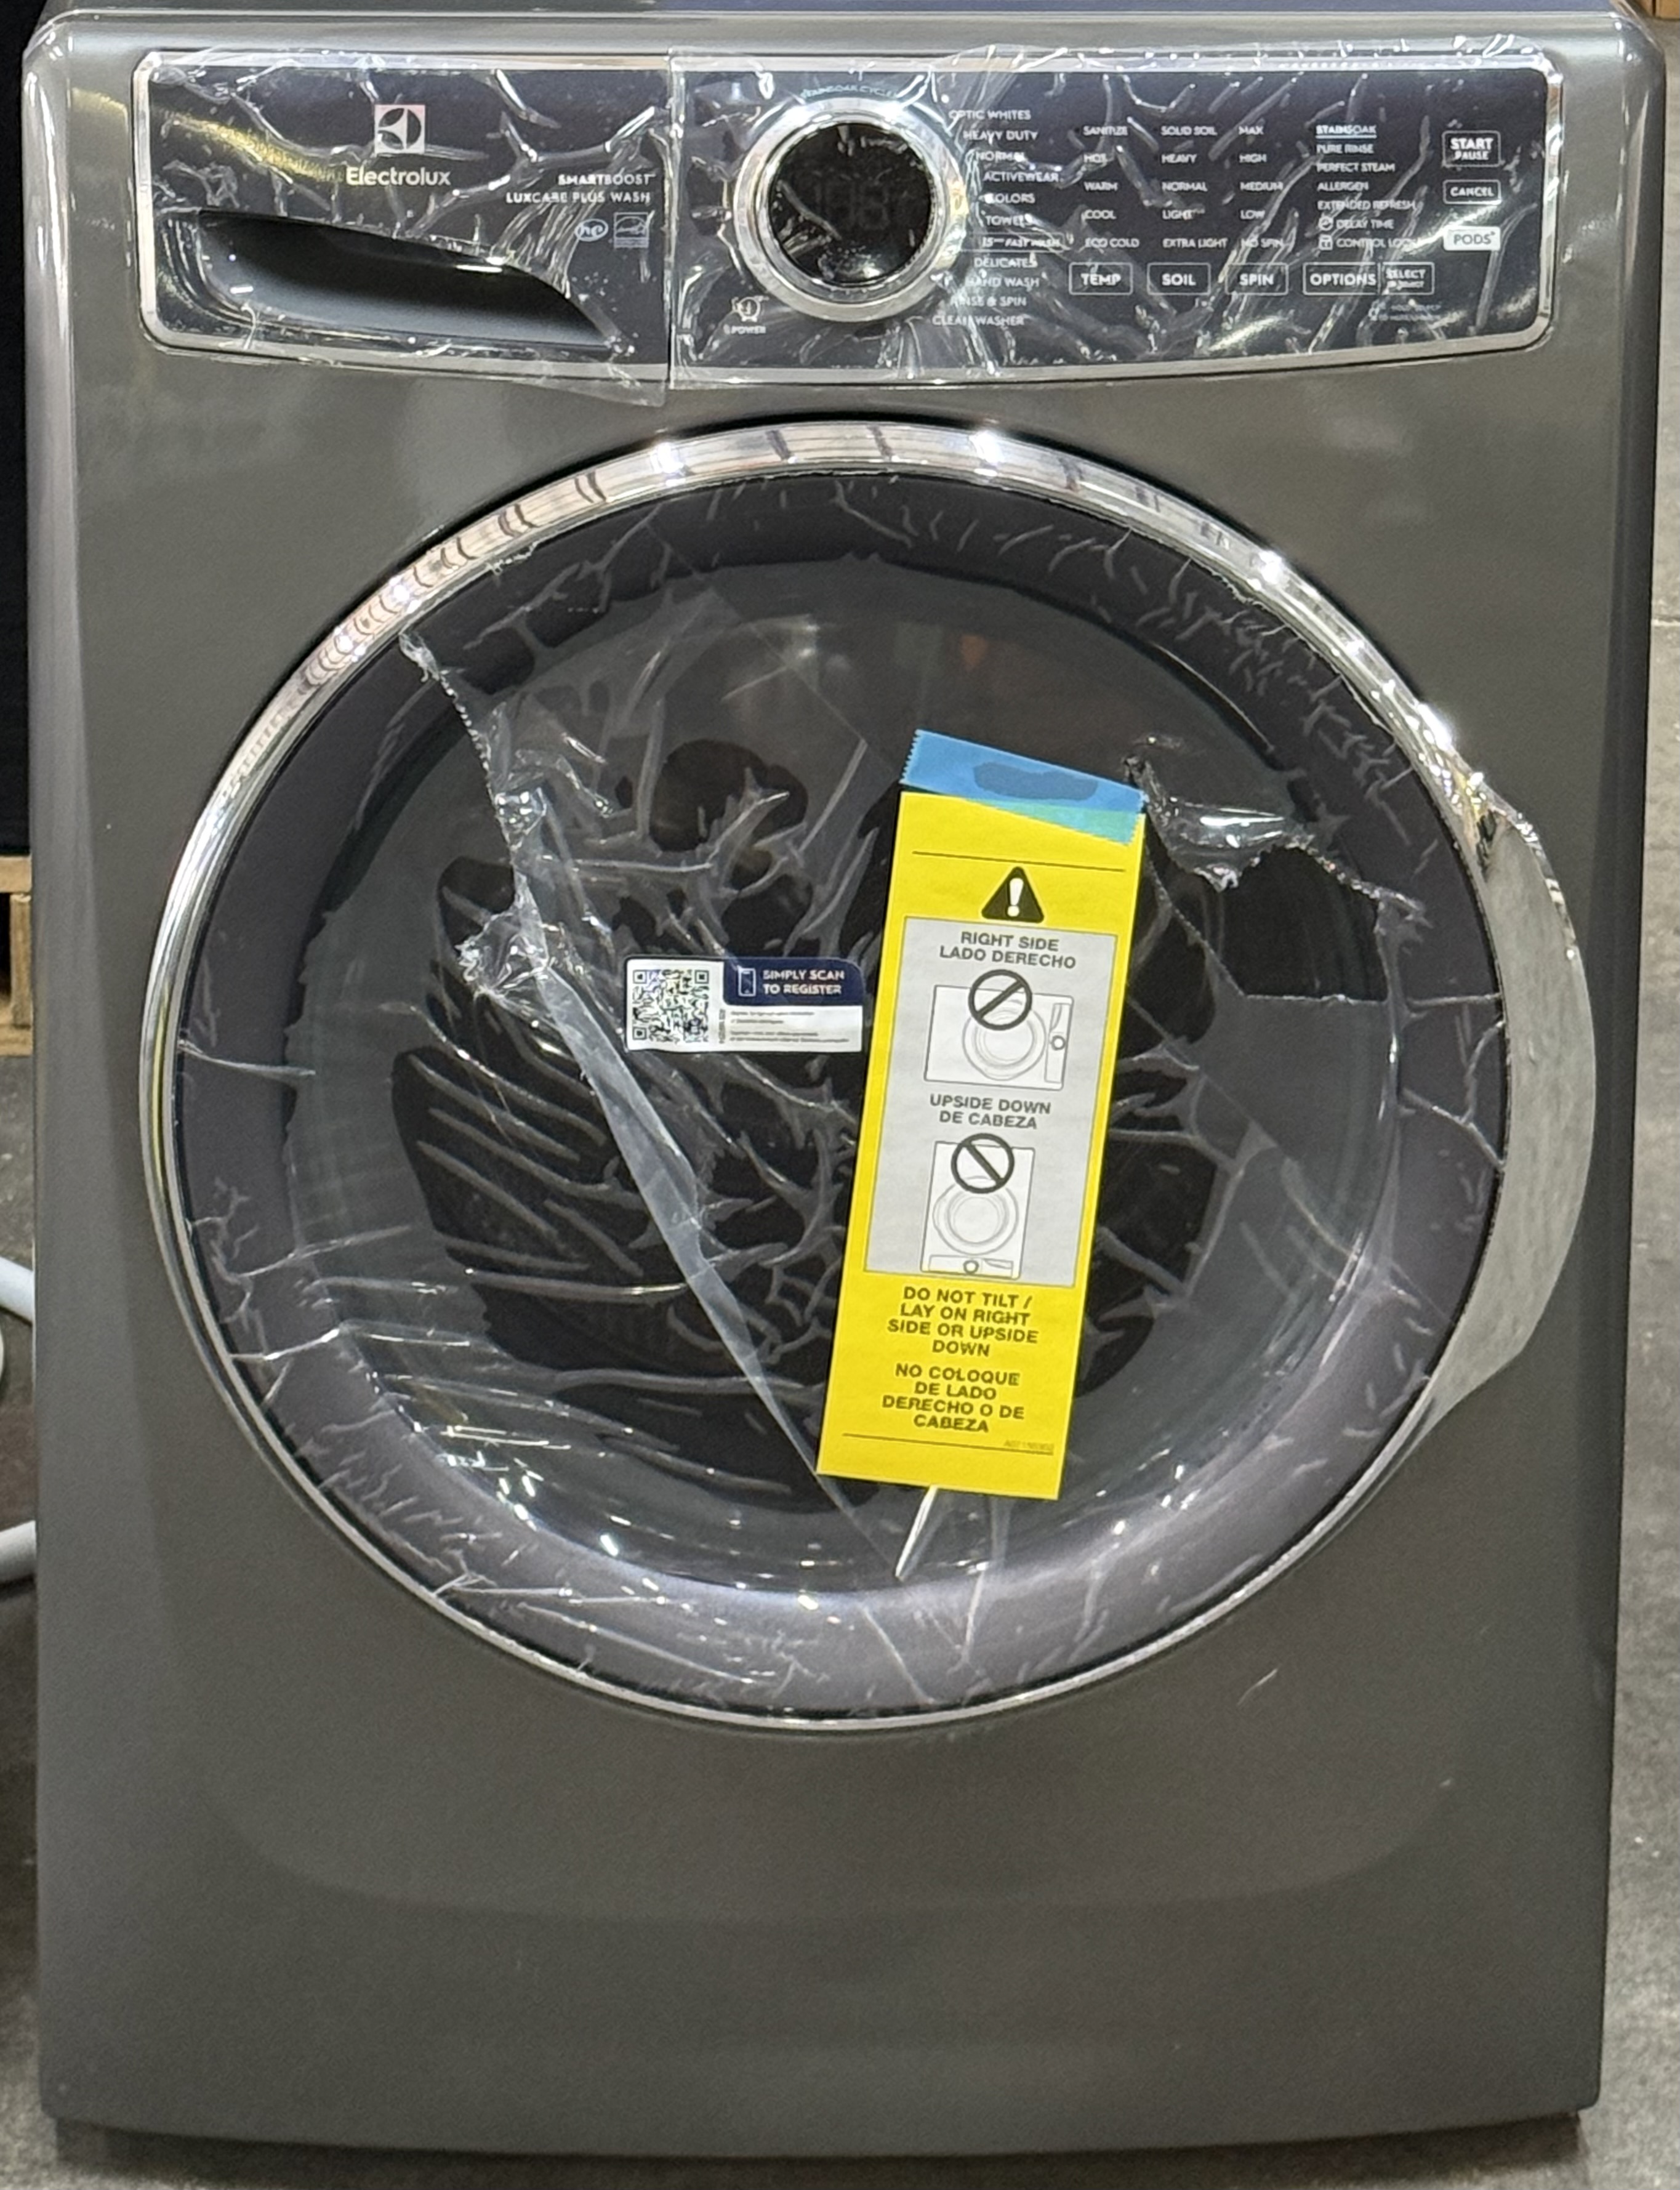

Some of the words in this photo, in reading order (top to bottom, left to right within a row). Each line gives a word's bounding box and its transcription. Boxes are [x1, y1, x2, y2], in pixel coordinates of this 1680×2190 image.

[948, 110, 985, 120] OPTIC
[987, 110, 1032, 121] WHITES
[1083, 126, 1128, 136] SANITIZE
[1161, 126, 1192, 136] SOLID
[1193, 126, 1218, 136] SOIL
[1238, 126, 1264, 135] MAX
[1316, 125, 1377, 135] STAINSOAK
[963, 131, 1003, 141] HEAVY
[1006, 131, 1039, 140] DUTY
[1316, 144, 1343, 154] PURE
[1344, 144, 1374, 154] RINSE
[1450, 137, 1494, 150] START
[1083, 154, 1109, 164] HOT
[1161, 154, 1198, 164] HEAVY
[1239, 154, 1267, 164] HIGH
[1454, 150, 1490, 161] PAUSE
[1317, 163, 1359, 172] PERFECT
[1361, 163, 1396, 172] STEAM
[345, 166, 451, 186] Electrolux
[558, 173, 650, 185] SMARTBOOST
[983, 171, 1059, 182] ACTIVEWEAR
[1083, 182, 1118, 191] WARM
[1162, 182, 1208, 192] NORMAL
[1240, 182, 1284, 191] MEDIUM
[1317, 182, 1369, 191] ALLERGEN
[1450, 186, 1495, 197] CANCEL
[505, 191, 568, 204] LUXCARE
[571, 191, 606, 204] PLUS
[609, 191, 651, 204] WASH
[985, 193, 1035, 204] OLORS
[1317, 200, 1371, 211] EXTENDED
[1372, 200, 1415, 211] REFRESH
[1084, 210, 1117, 220] COOL
[1162, 210, 1193, 220] LIGHT
[1240, 210, 1266, 220] LOW
[1336, 219, 1368, 230] DELAY
[1370, 219, 1394, 230] TIME
[1084, 238, 1108, 248] ECO
[1109, 238, 1140, 248] COLD
[1162, 238, 1196, 248] EXTRA
[1197, 238, 1229, 248] LIGHT
[1336, 238, 1386, 248] CONTROL
[1388, 238, 1418, 248] LOC
[974, 257, 1039, 268] DELICATES
[1386, 268, 1426, 279] SELECT
[1004, 277, 1040, 287] WASH
[1080, 273, 1122, 286] TEMP
[1161, 273, 1196, 286] SOIL
[1239, 274, 1274, 286] SPIN
[1309, 273, 1377, 286] OPTIONS
[999, 296, 1027, 306] SPIN
[975, 315, 1026, 326] WASHER
[960, 931, 1014, 949] RIGHT
[1018, 935, 1059, 952] SIDE
[939, 945, 986, 962] LADO
[991, 949, 1077, 970] DERECHO
[762, 969, 806, 981] SIMPLY
[809, 970, 845, 981] SCAN
[763, 983, 781, 995] TO
[782, 984, 842, 996] REGISTER
[930, 1093, 993, 1111] UPSIDE
[998, 1098, 1051, 1115] DOWN
[939, 1110, 963, 1125] DE
[968, 1113, 1037, 1130] CABEZA
[903, 1286, 930, 1301] DO
[936, 1288, 977, 1304] NOT
[981, 1292, 1019, 1309] TILT
[899, 1302, 934, 1318] LAY
[939, 1305, 967, 1322] ON
[973, 1308, 1031, 1327] RIGHT
[886, 1318, 931, 1335] SIDE
[937, 1322, 964, 1338] OR
[969, 1326, 1040, 1344] UPSIDE
[931, 1339, 991, 1357] DOWN
[894, 1362, 923, 1378] NO
[928, 1365, 1021, 1387] COLOQUE
[914, 1380, 941, 1396] DE
[946, 1383, 997, 1401] LADO
[882, 1394, 975, 1414] DERECHO
[979, 1402, 994, 1417] O
[999, 1404, 1025, 1420] DE
[913, 1414, 990, 1433] CABEZA
